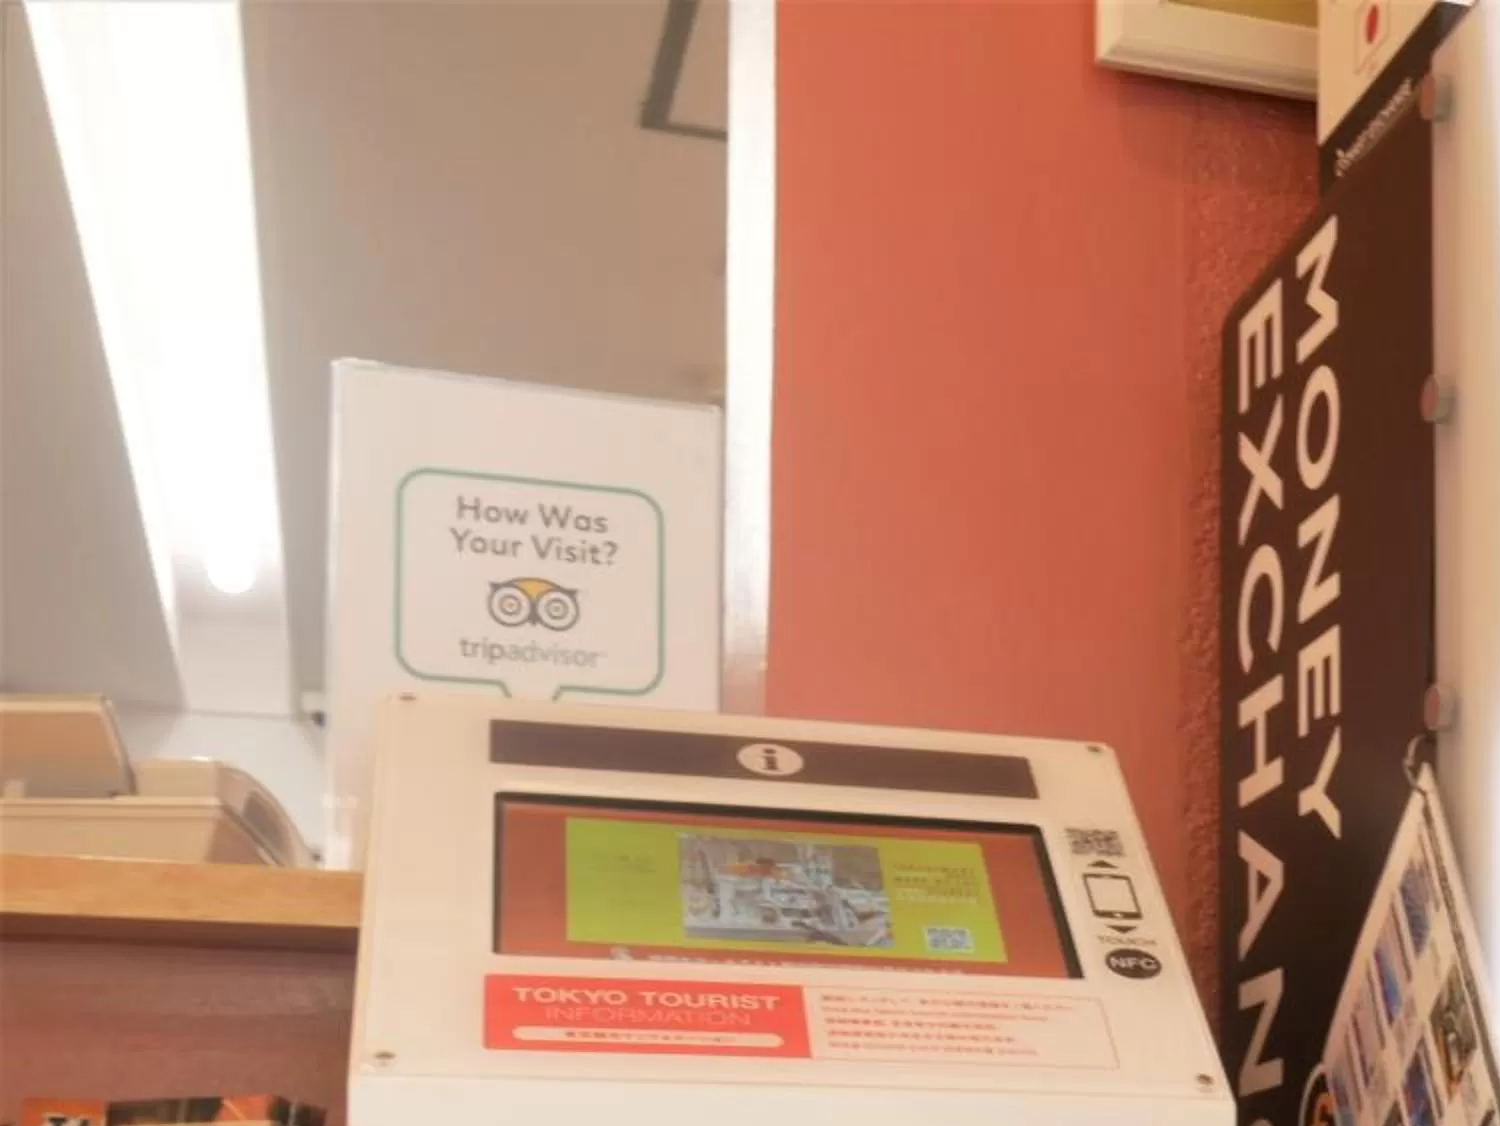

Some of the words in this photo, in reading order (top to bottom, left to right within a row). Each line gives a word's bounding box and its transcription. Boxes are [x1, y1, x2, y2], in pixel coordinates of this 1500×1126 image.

[455, 495, 529, 526] How
[538, 502, 609, 534] Was
[1297, 213, 1341, 839] MONEY
[449, 526, 523, 559] Your
[532, 534, 619, 566] Visit?
[458, 636, 601, 670] tripadvisor
[1110, 956, 1157, 971] NFC
[513, 987, 628, 1006] TOKYO
[637, 990, 781, 1011] TOURIST
[544, 1005, 751, 1026] INFORMATION
